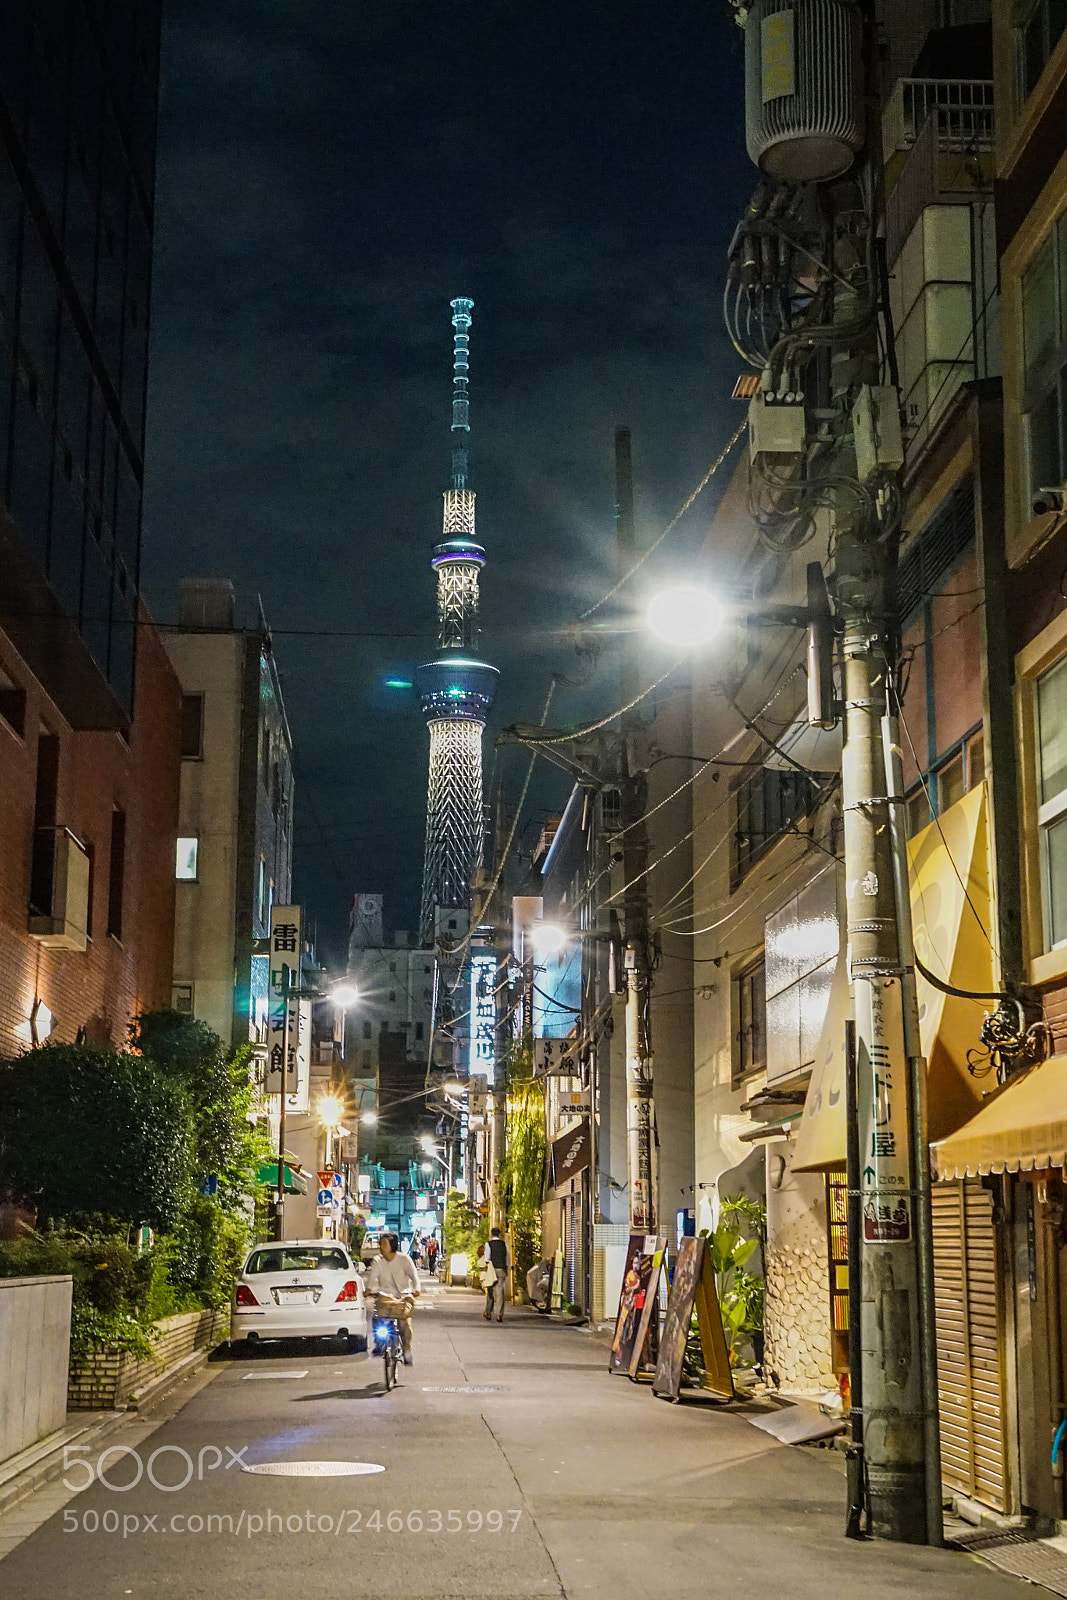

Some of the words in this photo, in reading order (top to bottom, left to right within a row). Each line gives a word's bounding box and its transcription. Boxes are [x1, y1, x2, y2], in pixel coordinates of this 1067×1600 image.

[270, 924, 298, 1074] 雷門会館
[869, 1043, 897, 1158] ミドリ屋
[878, 1175, 906, 1186] この先
[878, 1205, 906, 1223] 浅草
